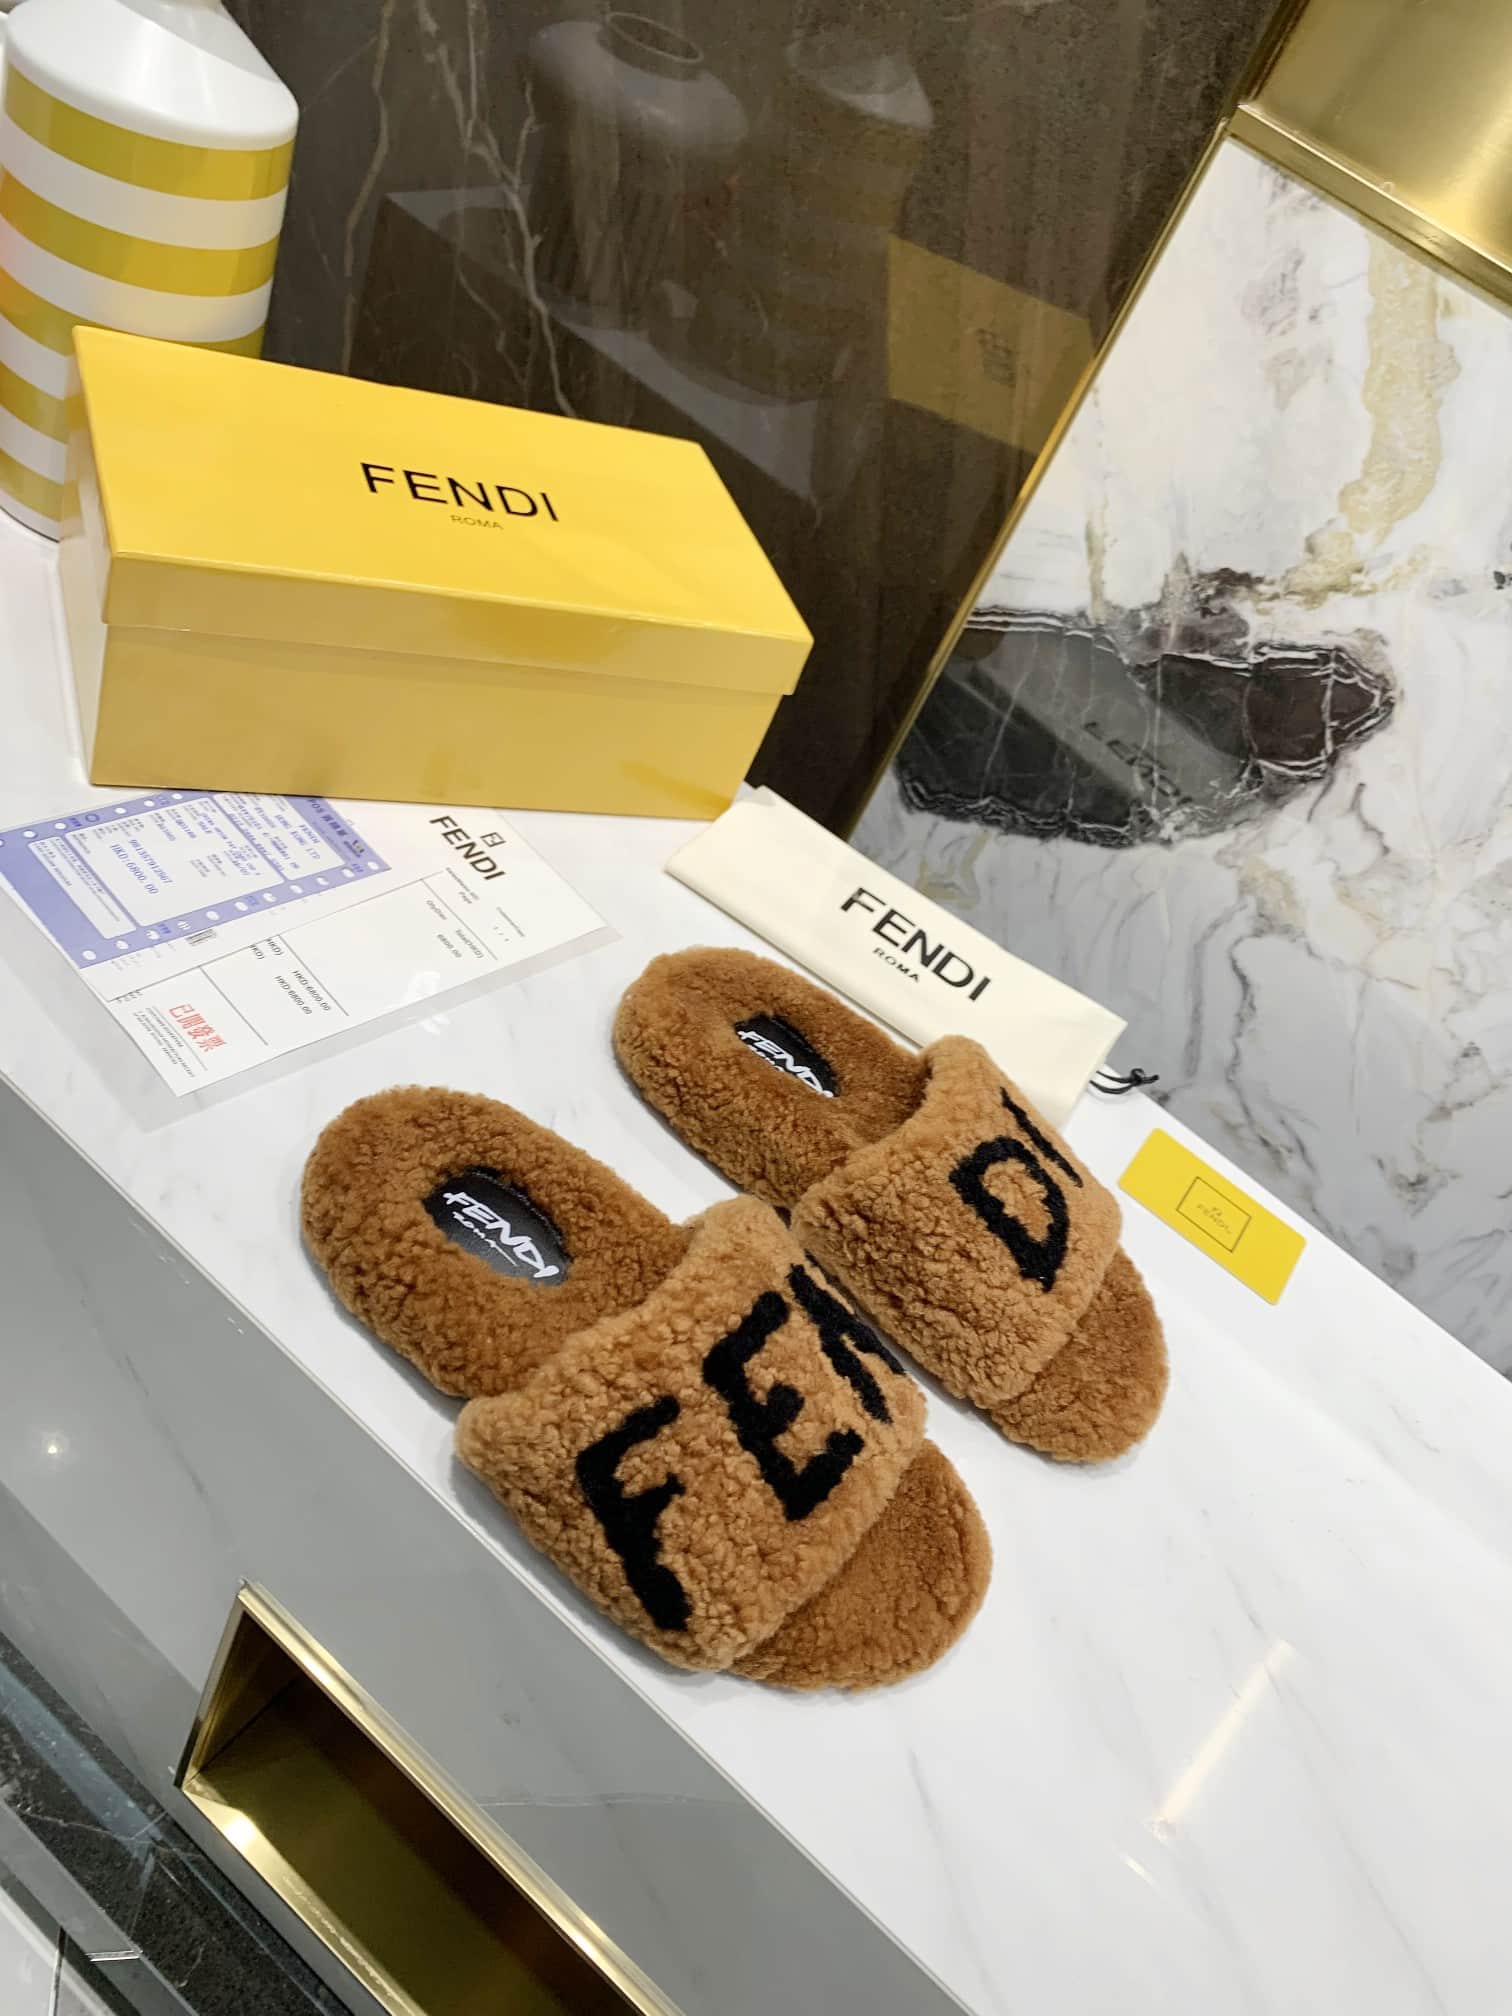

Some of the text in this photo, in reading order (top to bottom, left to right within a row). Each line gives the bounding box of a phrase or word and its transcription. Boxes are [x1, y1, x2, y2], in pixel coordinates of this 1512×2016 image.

[360, 462, 560, 522] FENDI
[450, 514, 504, 530] ROMA
[429, 815, 505, 880] FENDI
[840, 887, 991, 1002] FENDI
[872, 946, 921, 984] ROMA
[443, 1191, 560, 1278] FENDI
